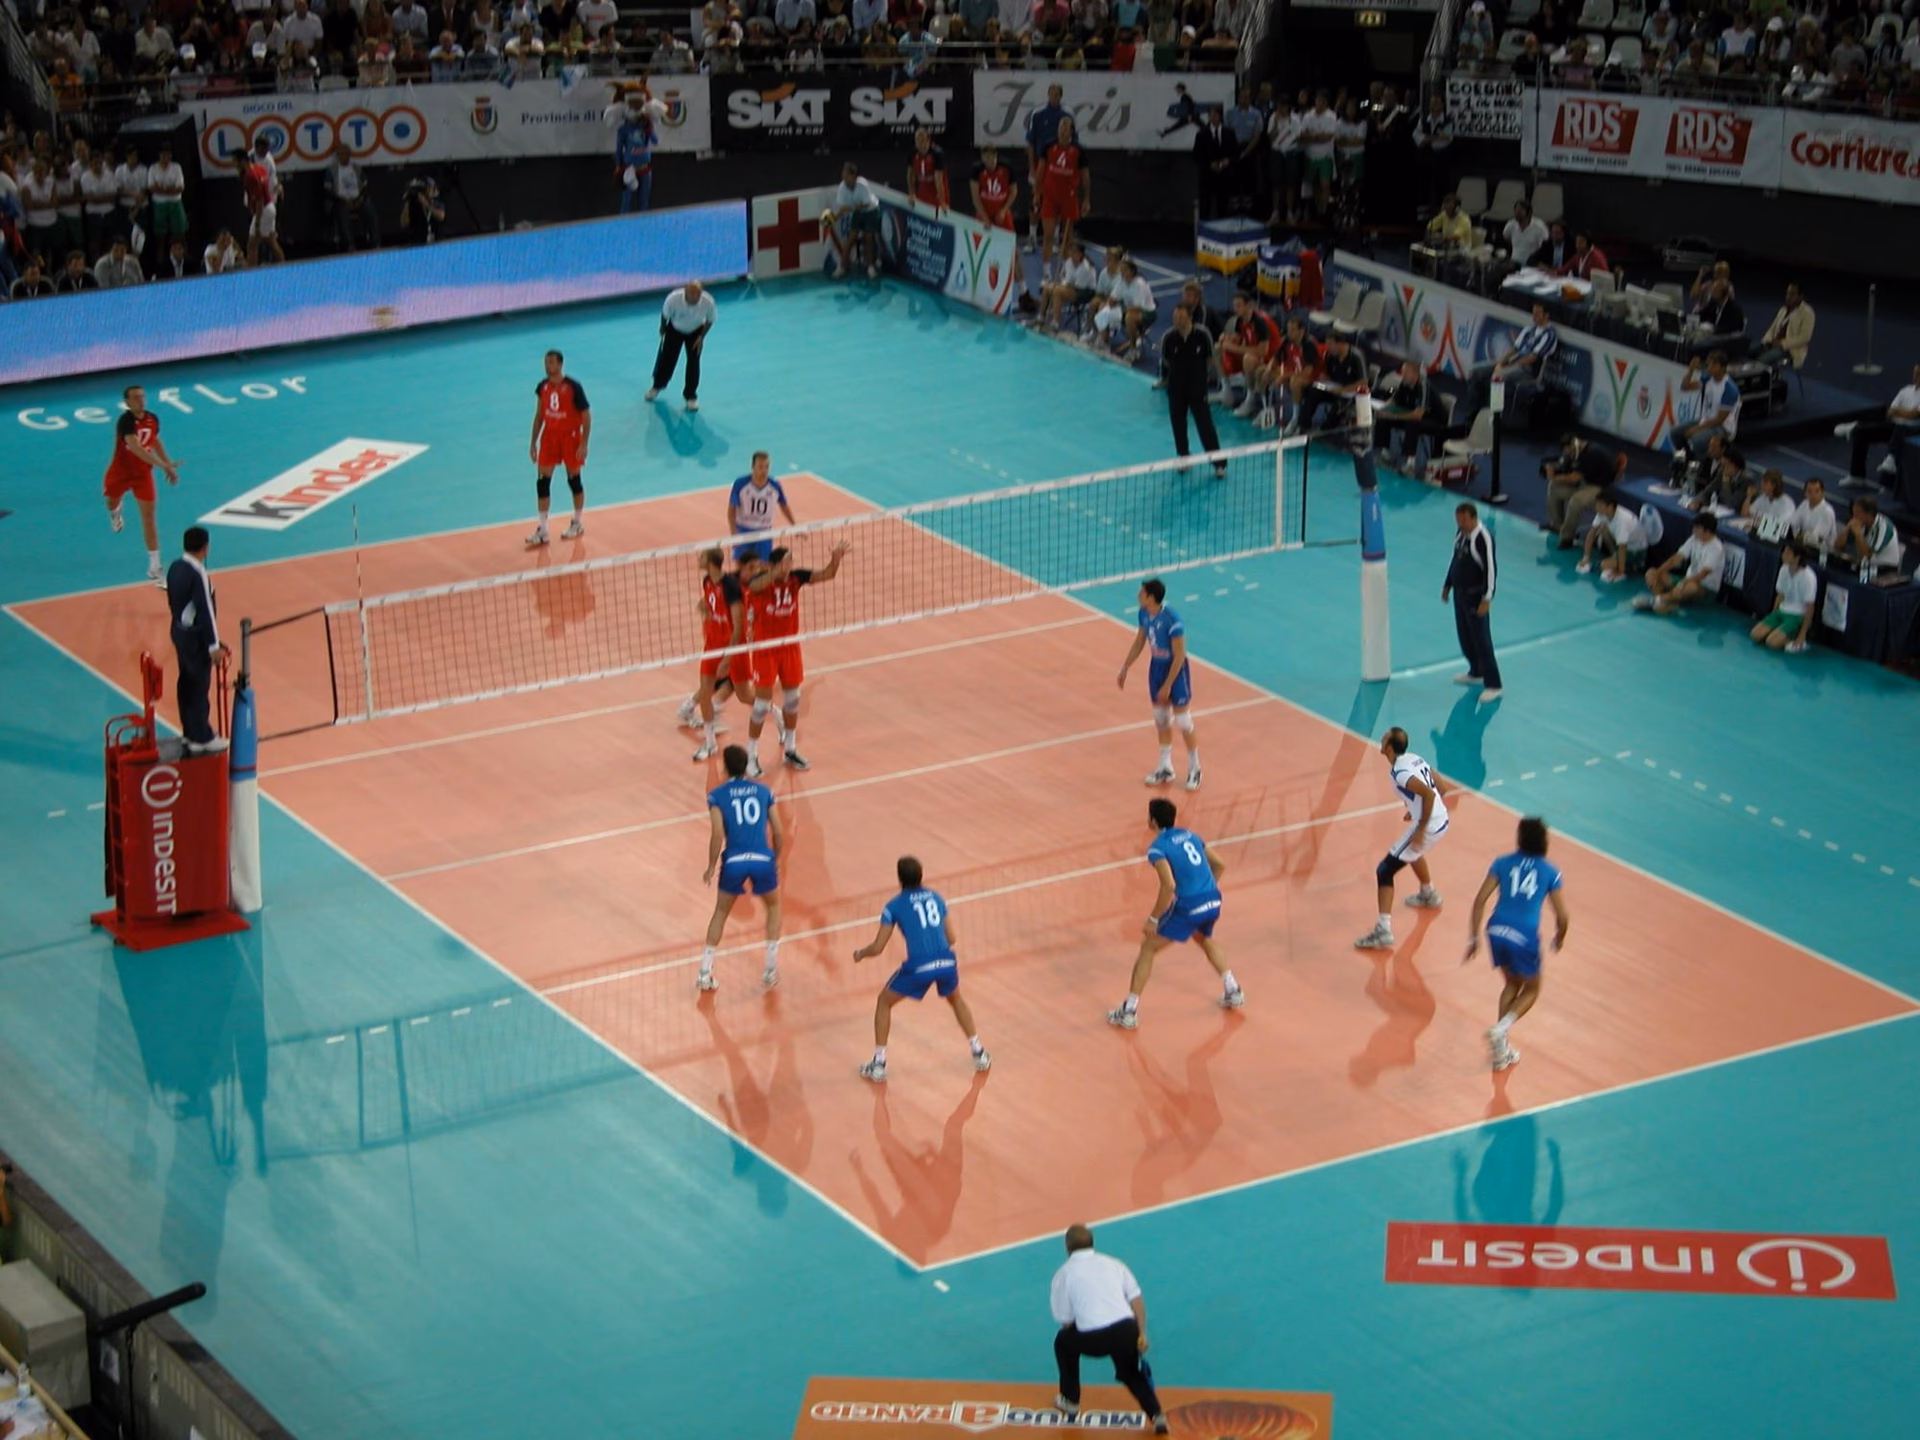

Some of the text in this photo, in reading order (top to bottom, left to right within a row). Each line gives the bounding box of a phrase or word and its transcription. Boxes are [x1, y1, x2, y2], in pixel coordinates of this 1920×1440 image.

[521, 112, 580, 124] Provincia
[584, 110, 596, 122] di
[1563, 102, 1622, 144] RDS
[1676, 109, 1736, 152] RDS
[1791, 131, 1910, 177] Corriere
[987, 176, 1003, 193] 16
[17, 375, 307, 431] Geflor
[549, 390, 560, 412] 8
[750, 497, 768, 515] 10
[773, 587, 793, 609] 14
[730, 796, 761, 826] 10
[1183, 840, 1202, 867] 8
[1508, 865, 1539, 901] 14
[912, 898, 941, 930] 18
